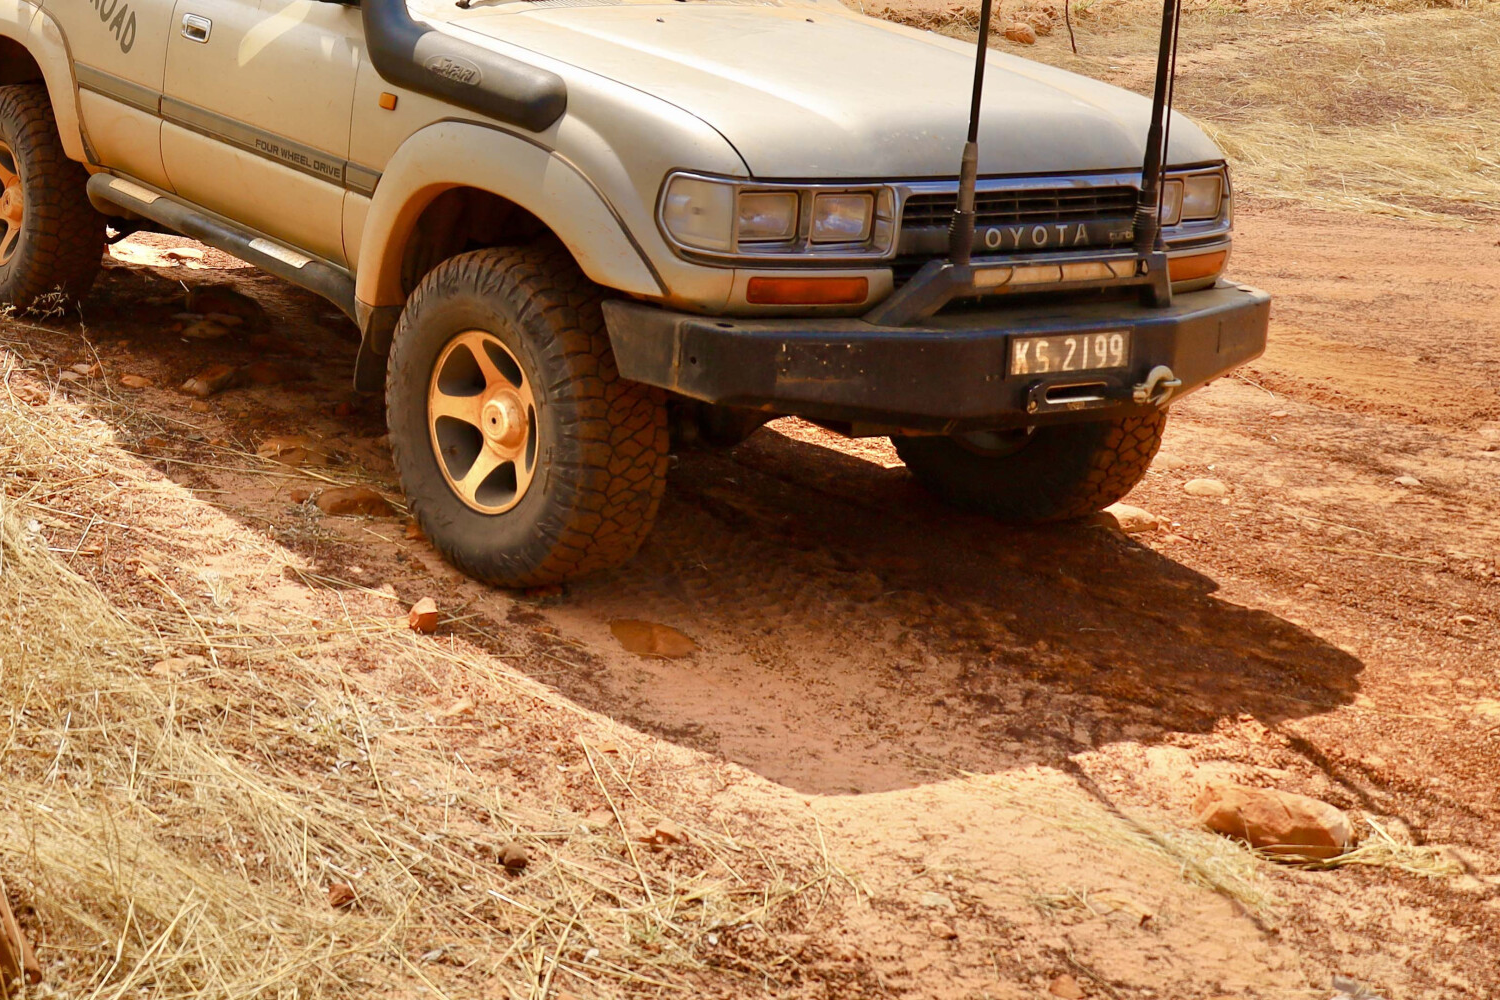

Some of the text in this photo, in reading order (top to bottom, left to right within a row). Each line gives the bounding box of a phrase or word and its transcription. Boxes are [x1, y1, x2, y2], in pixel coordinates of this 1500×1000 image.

[255, 138, 341, 178] FOUR WHEEL DRIVE
[974, 224, 1090, 249] OYOTA
[1062, 334, 1124, 371] 2199
